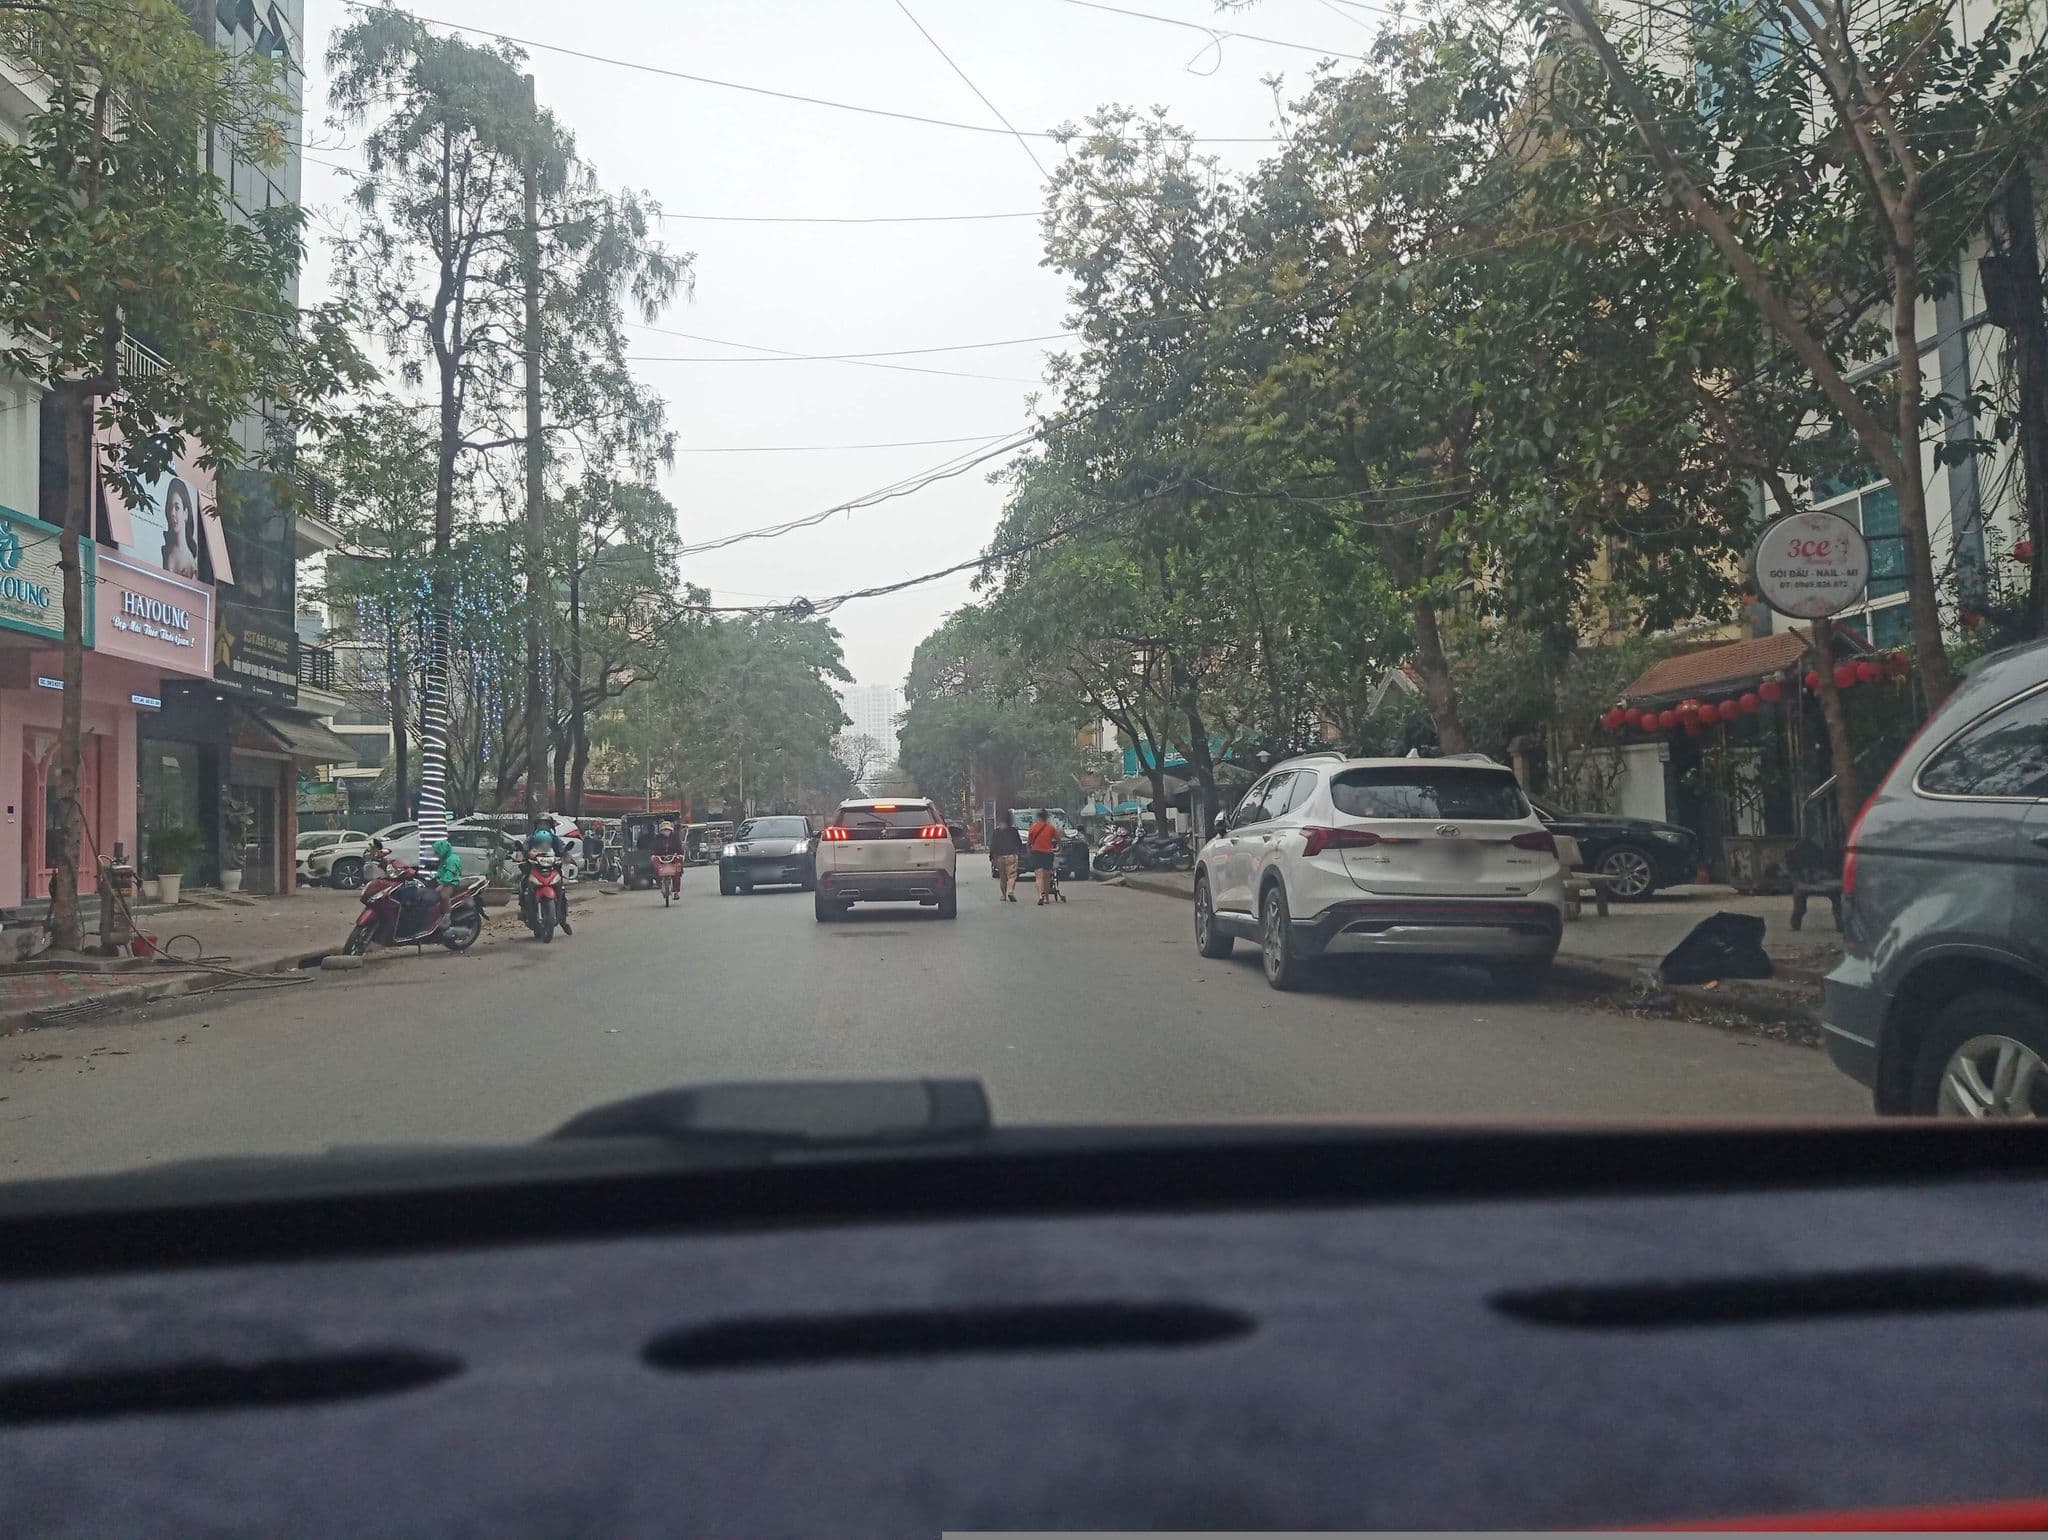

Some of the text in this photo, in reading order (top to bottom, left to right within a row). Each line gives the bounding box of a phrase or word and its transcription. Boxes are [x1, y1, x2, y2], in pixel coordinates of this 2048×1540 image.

[1787, 538, 1832, 558] 3ce
[1816, 569, 1838, 577] NAIL
[0, 574, 49, 610] OUNG
[123, 591, 189, 630] HAYOUNG
